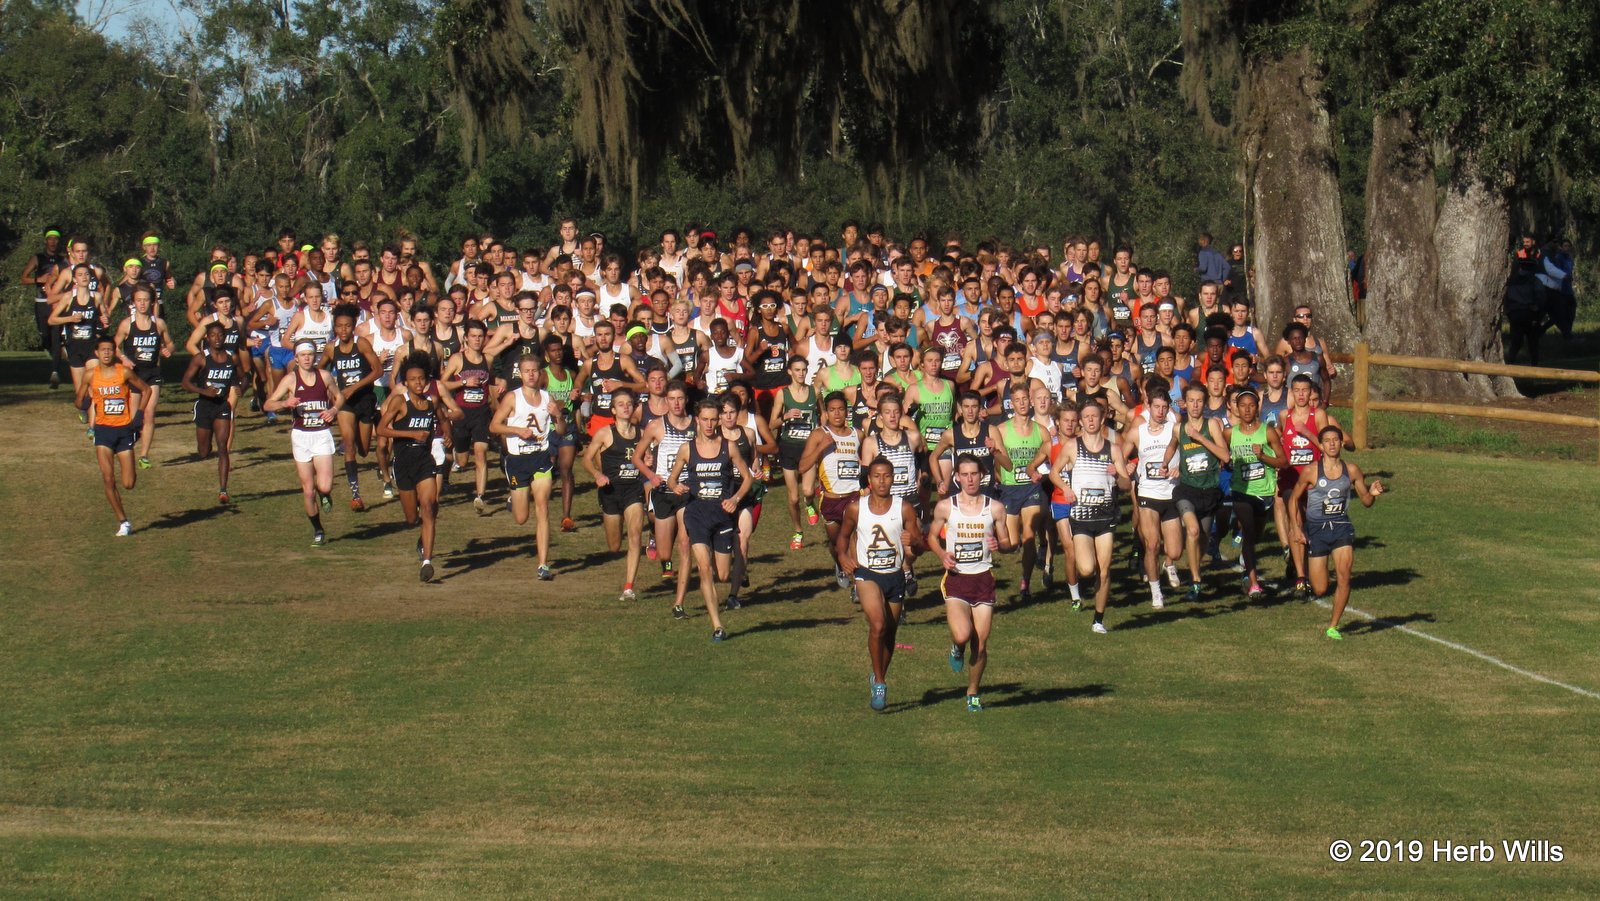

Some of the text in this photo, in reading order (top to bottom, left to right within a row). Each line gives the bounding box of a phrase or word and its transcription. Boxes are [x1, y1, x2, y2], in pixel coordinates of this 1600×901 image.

[132, 336, 157, 347] BEARS
[138, 352, 152, 360] 42
[336, 359, 360, 370] BEARS
[207, 369, 232, 379] BEARS
[98, 385, 121, 395] TKHS
[104, 404, 125, 412] 1710
[303, 418, 324, 426] 1134
[788, 429, 812, 437] 1762
[974, 448, 990, 457] BOCA
[695, 463, 722, 472] DWYER
[838, 468, 860, 476] 1553
[698, 488, 723, 496] 495
[1325, 504, 1343, 512] 371
[871, 525, 896, 548] A
[955, 550, 983, 559] 1550
[868, 557, 895, 565] 1635
